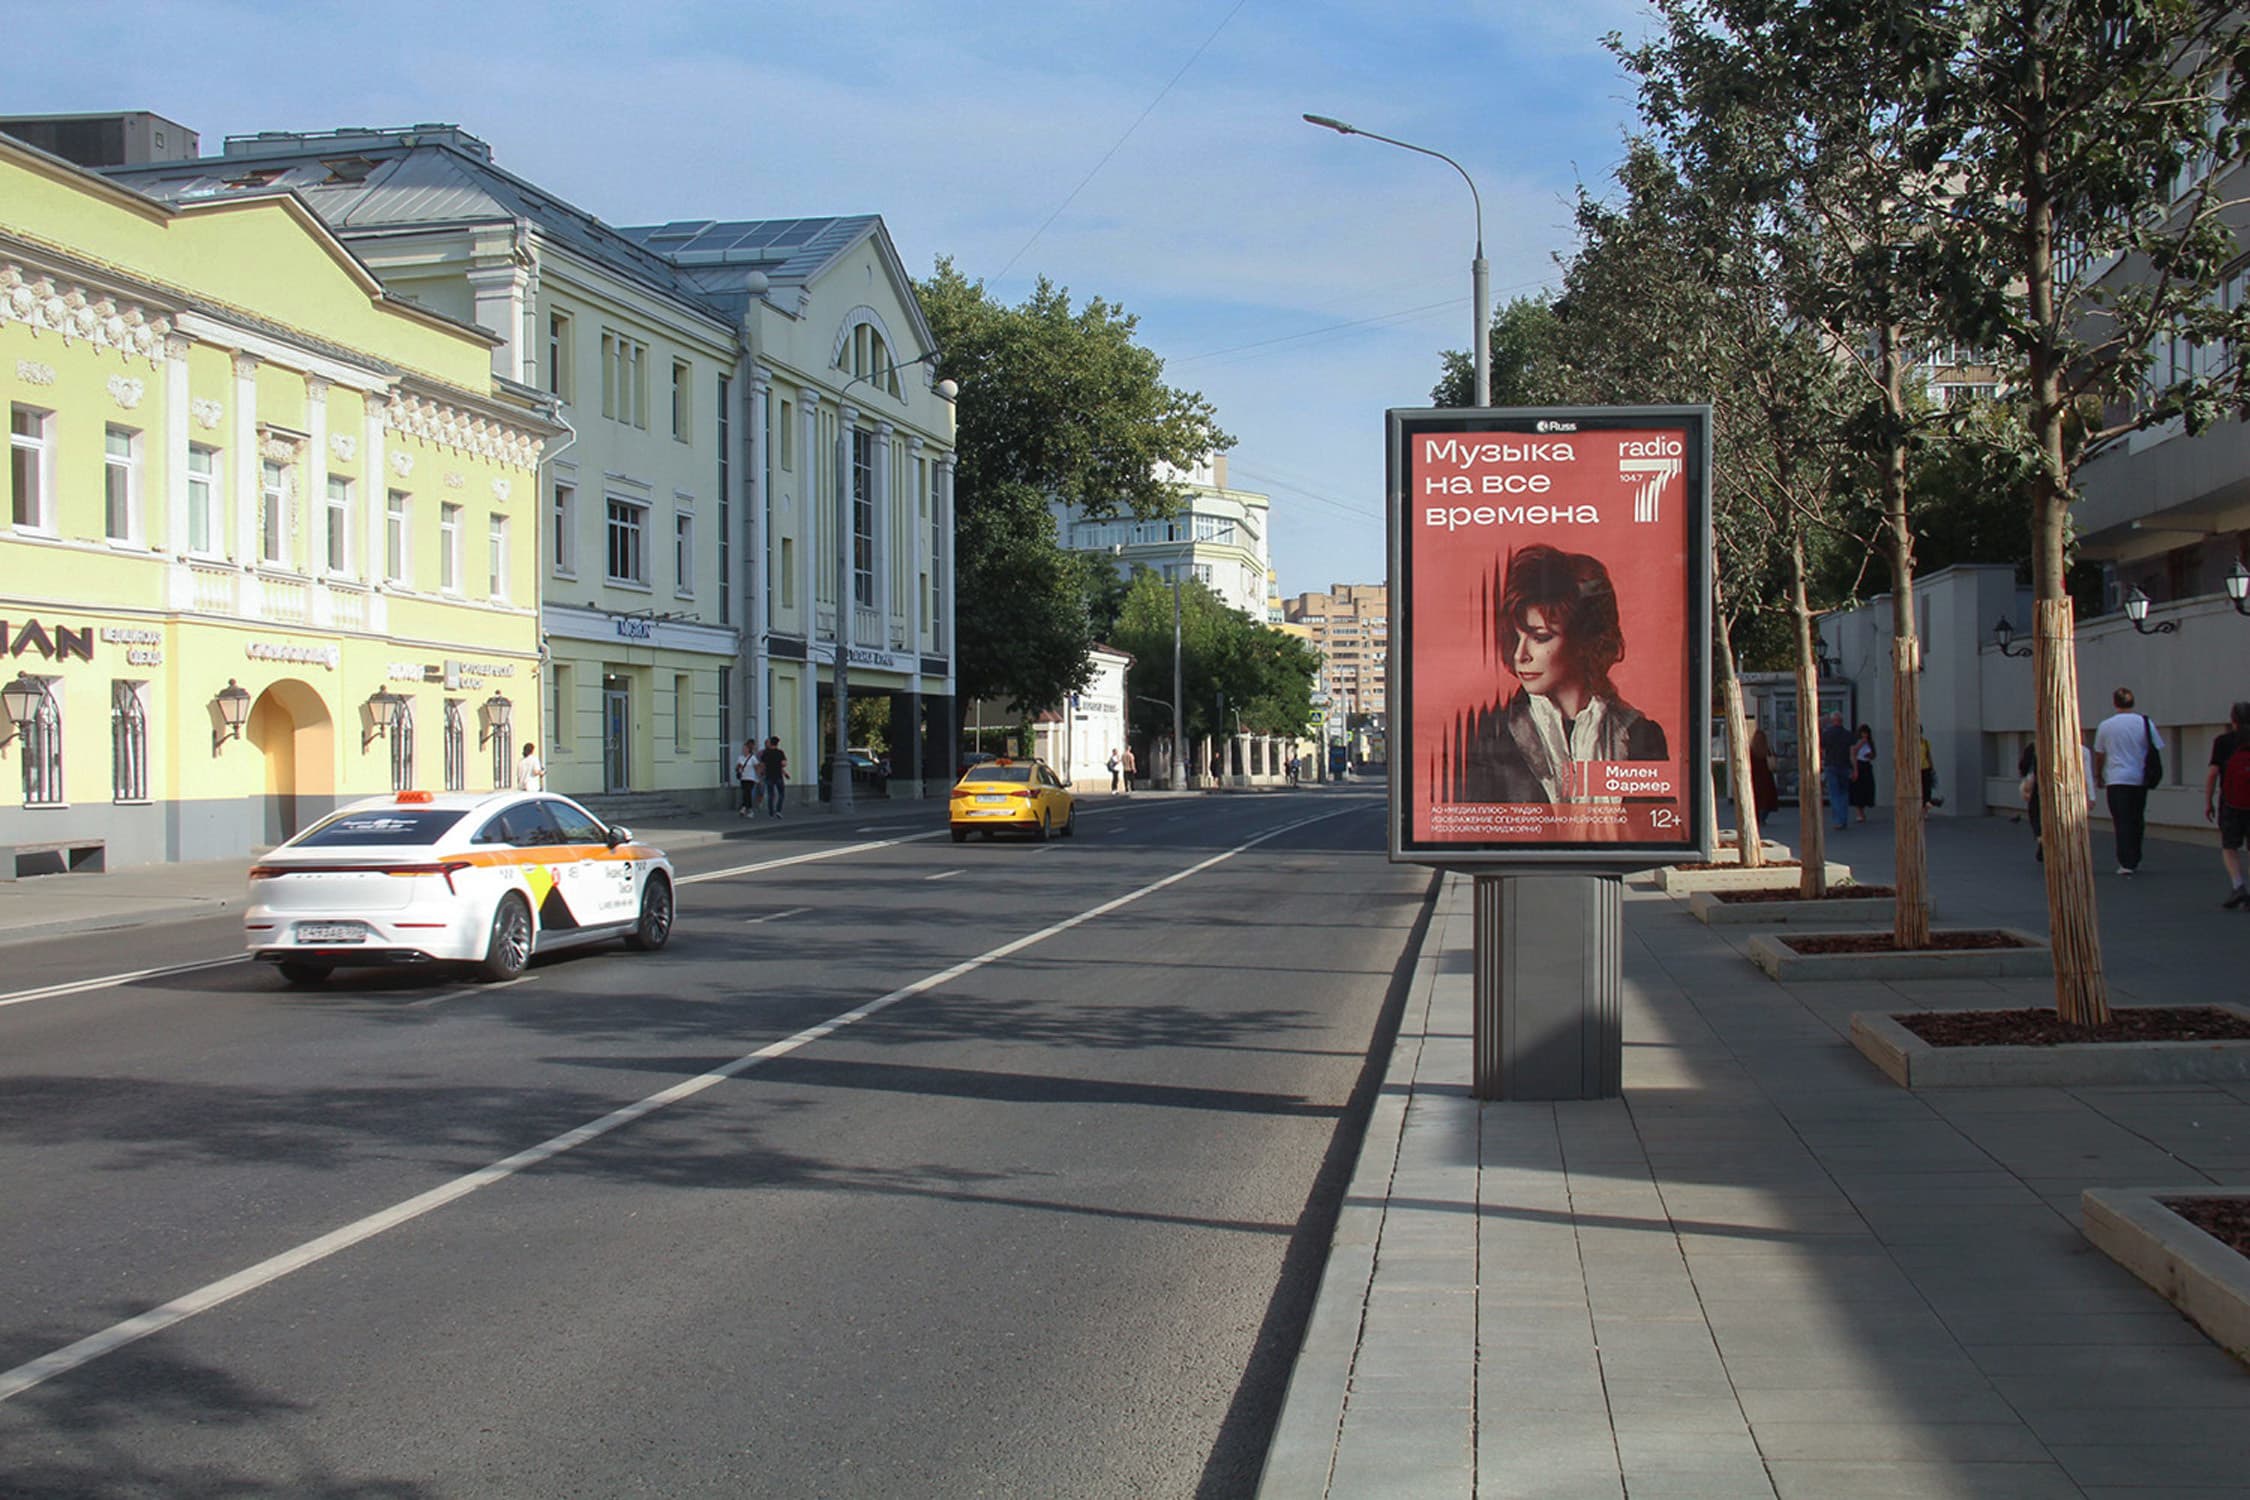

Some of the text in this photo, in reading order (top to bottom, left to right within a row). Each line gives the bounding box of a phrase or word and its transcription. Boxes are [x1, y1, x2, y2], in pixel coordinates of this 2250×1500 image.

[1549, 421, 1577, 432] Russ
[1426, 439, 1576, 469] Музыка
[1618, 436, 1682, 456] radio
[1426, 475, 1551, 495] на все
[1426, 504, 1600, 531] времена
[1605, 765, 1658, 777] Милен
[1605, 779, 1671, 794] Фармер
[1649, 808, 1682, 828] 12+
